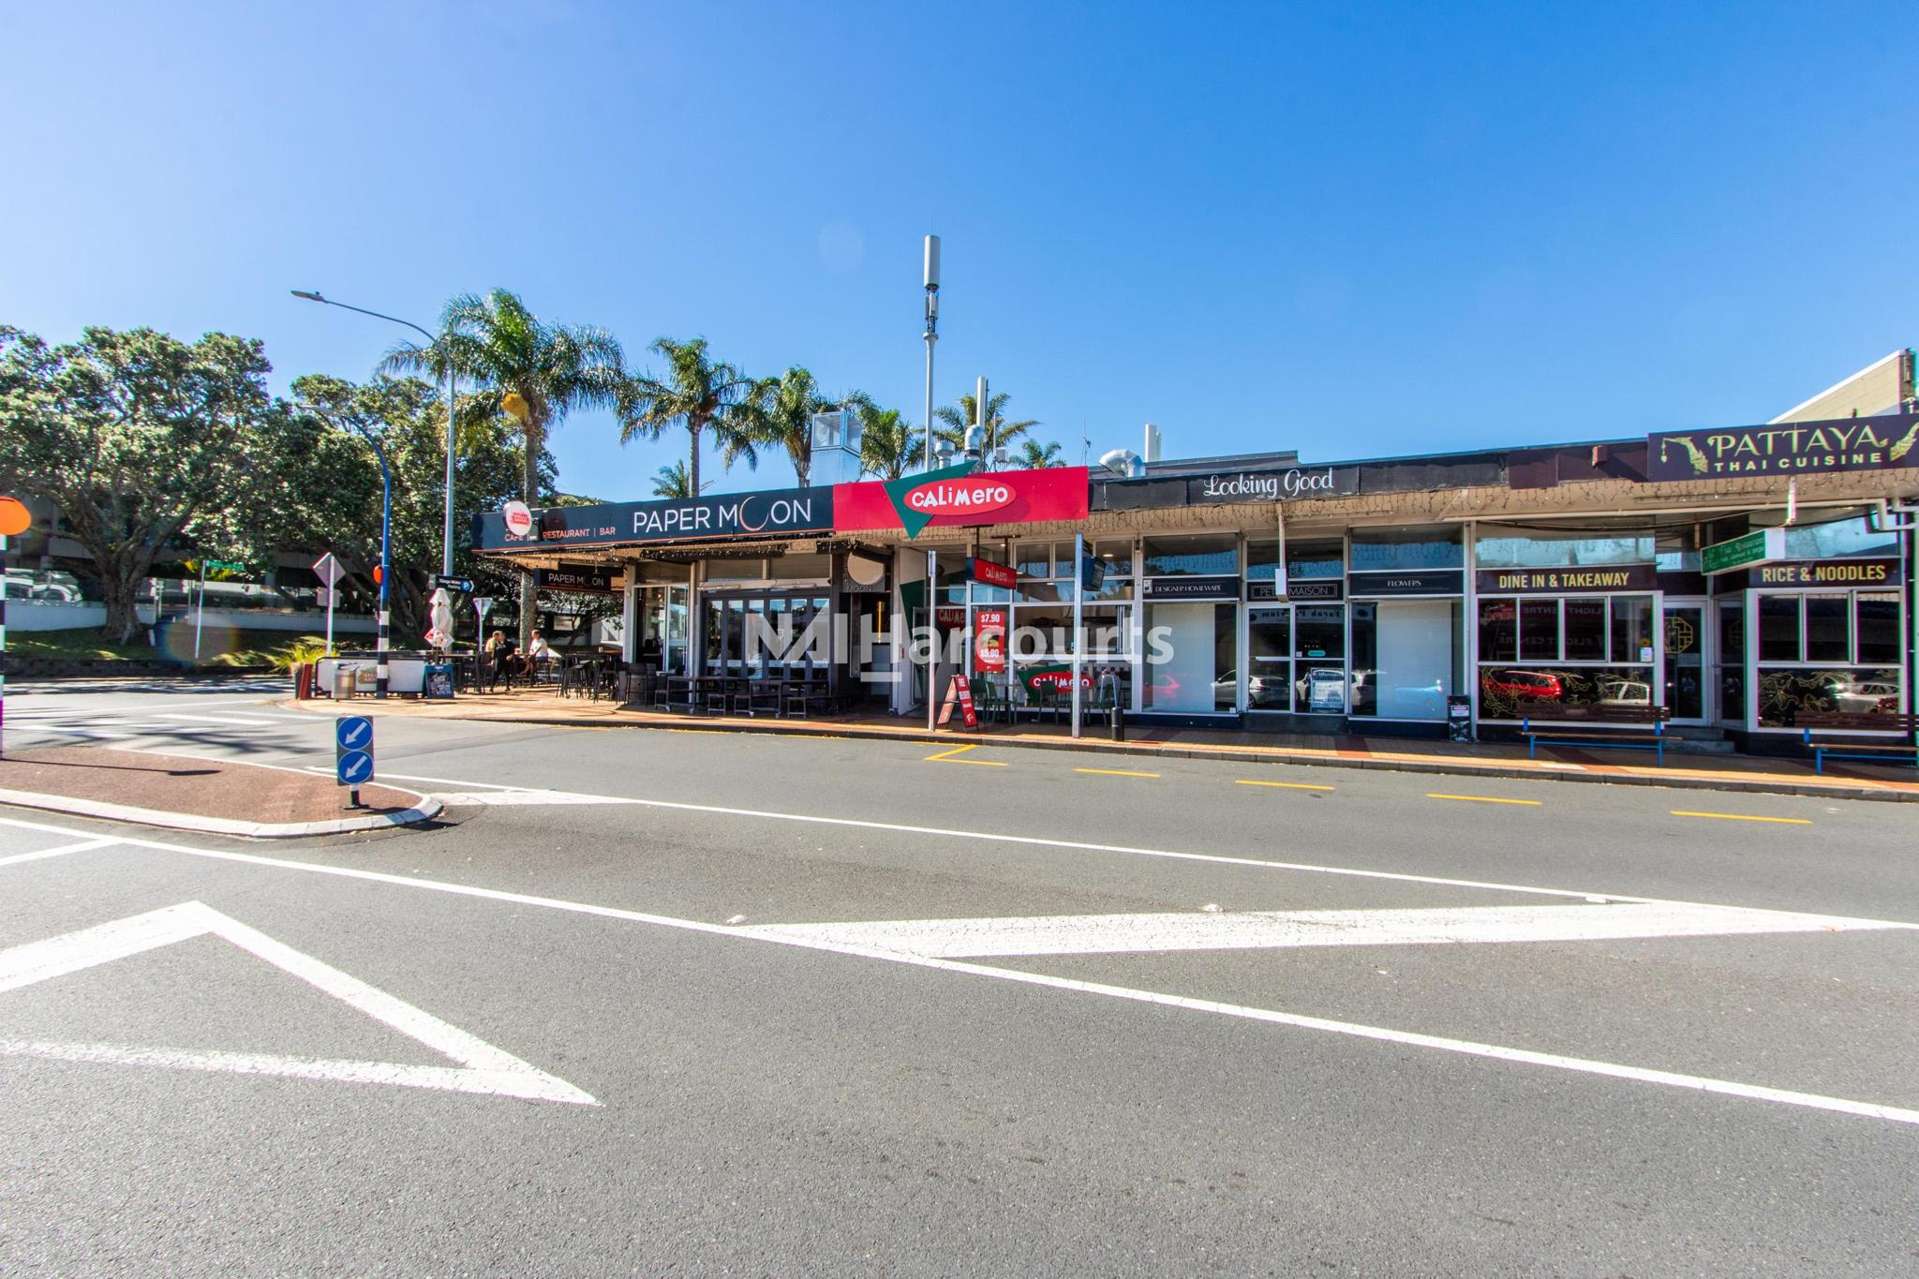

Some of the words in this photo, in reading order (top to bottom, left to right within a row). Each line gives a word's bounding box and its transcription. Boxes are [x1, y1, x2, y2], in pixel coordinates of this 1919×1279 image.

[1707, 424, 1889, 458] PATTAYA
[1714, 459, 1768, 473] THAI
[1778, 452, 1882, 469] CUISINE
[1203, 472, 1278, 498] Looking
[1284, 467, 1335, 497] Good
[633, 506, 711, 534] PAPER
[599, 526, 616, 536] BAR
[548, 573, 576, 584] PAPER
[576, 575, 604, 586] MON
[1499, 575, 1528, 589] DINE
[1532, 574, 1545, 588] IN
[1549, 573, 1559, 587] &
[1561, 572, 1630, 587] TAKEAWAY
[1762, 566, 1796, 582] RICE
[1800, 567, 1812, 582] &
[1815, 565, 1886, 581] NOODLES
[980, 614, 1000, 623] $7.90
